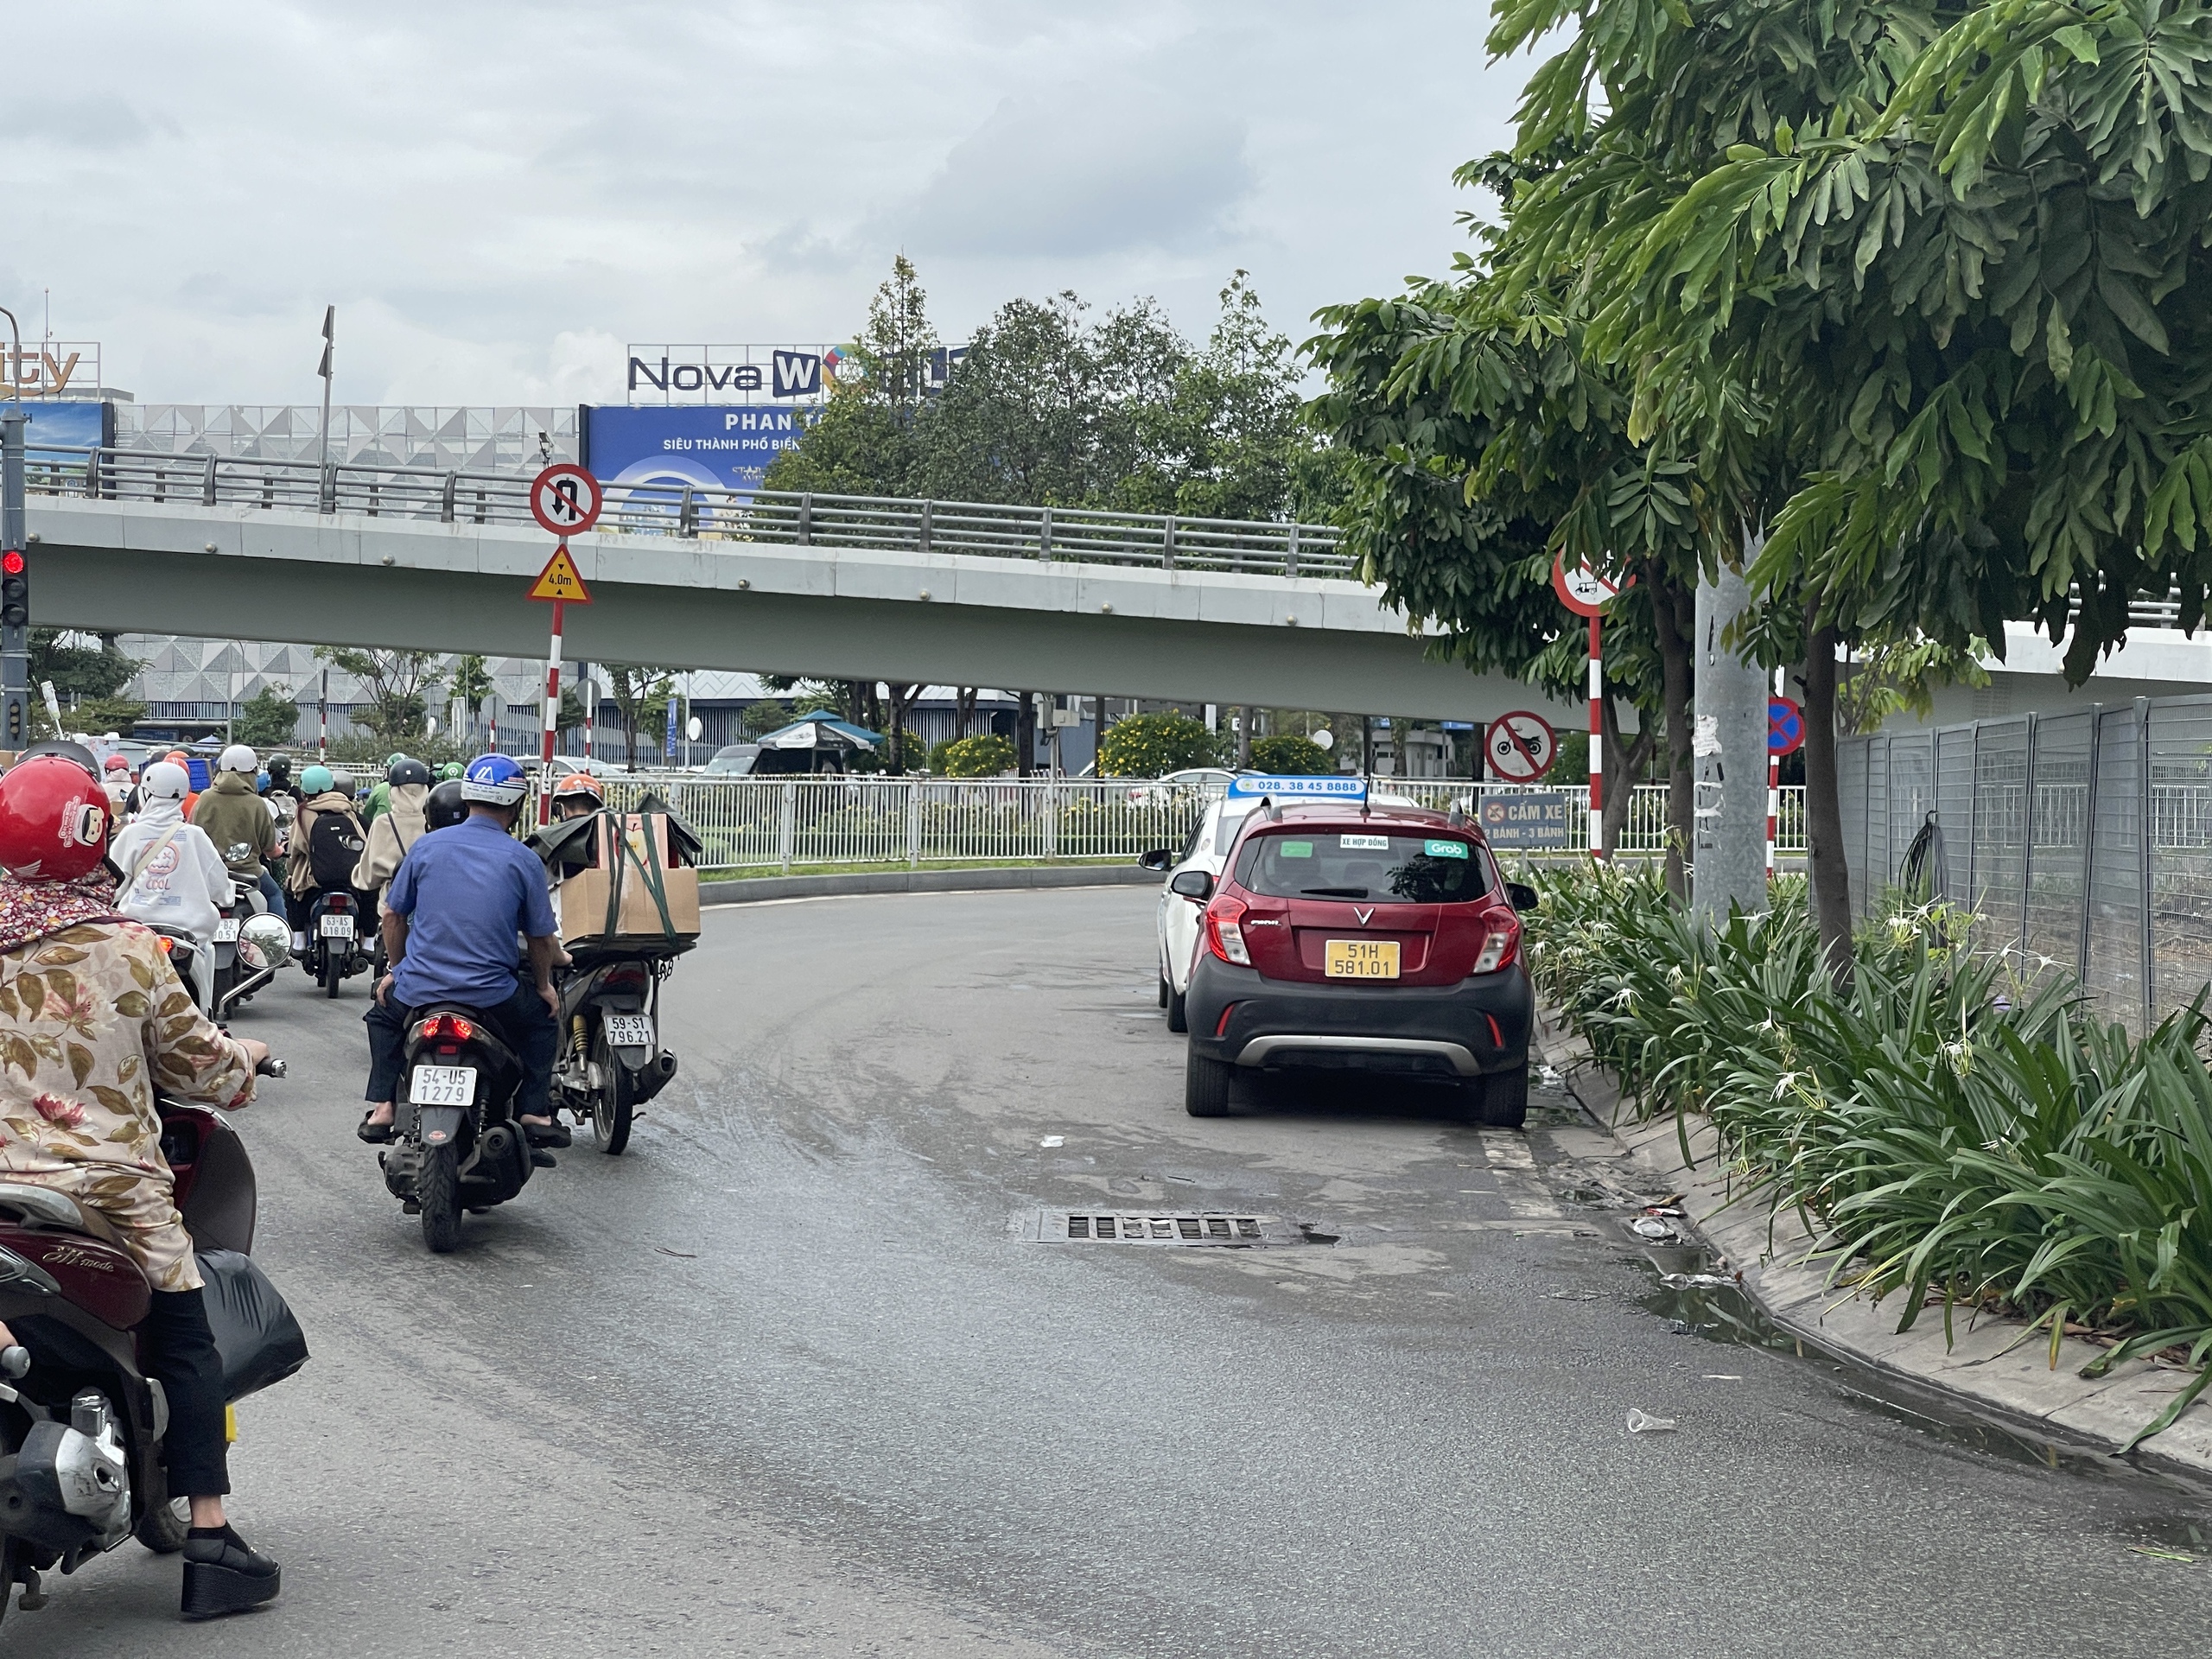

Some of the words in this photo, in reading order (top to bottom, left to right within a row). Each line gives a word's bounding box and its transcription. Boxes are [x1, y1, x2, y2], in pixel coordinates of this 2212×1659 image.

[726, 413, 791, 430] PHAN
[664, 437, 692, 450] SIÊU
[695, 437, 739, 450] THÀNH
[742, 436, 768, 450] PHỐ
[549, 574, 571, 585] 4.0m
[1258, 781, 1285, 791] 028.
[1289, 781, 1304, 791] 38
[1308, 782, 1322, 791] 45
[1327, 782, 1357, 791] 8888
[1508, 800, 1540, 821] CẤM
[1544, 804, 1563, 820] XE
[1484, 828, 1491, 840] 2
[1529, 828, 1535, 838] 3
[1342, 837, 1351, 846] XE
[1431, 842, 1462, 855] Grab
[1348, 944, 1379, 958] 51H
[1335, 960, 1389, 976] 581.01
[612, 1017, 645, 1029] 59-S1
[610, 1030, 651, 1043] 796.21
[423, 1069, 467, 1085] 54-U5
[422, 1085, 464, 1102] 1279
[79, 1259, 114, 1272] mode
